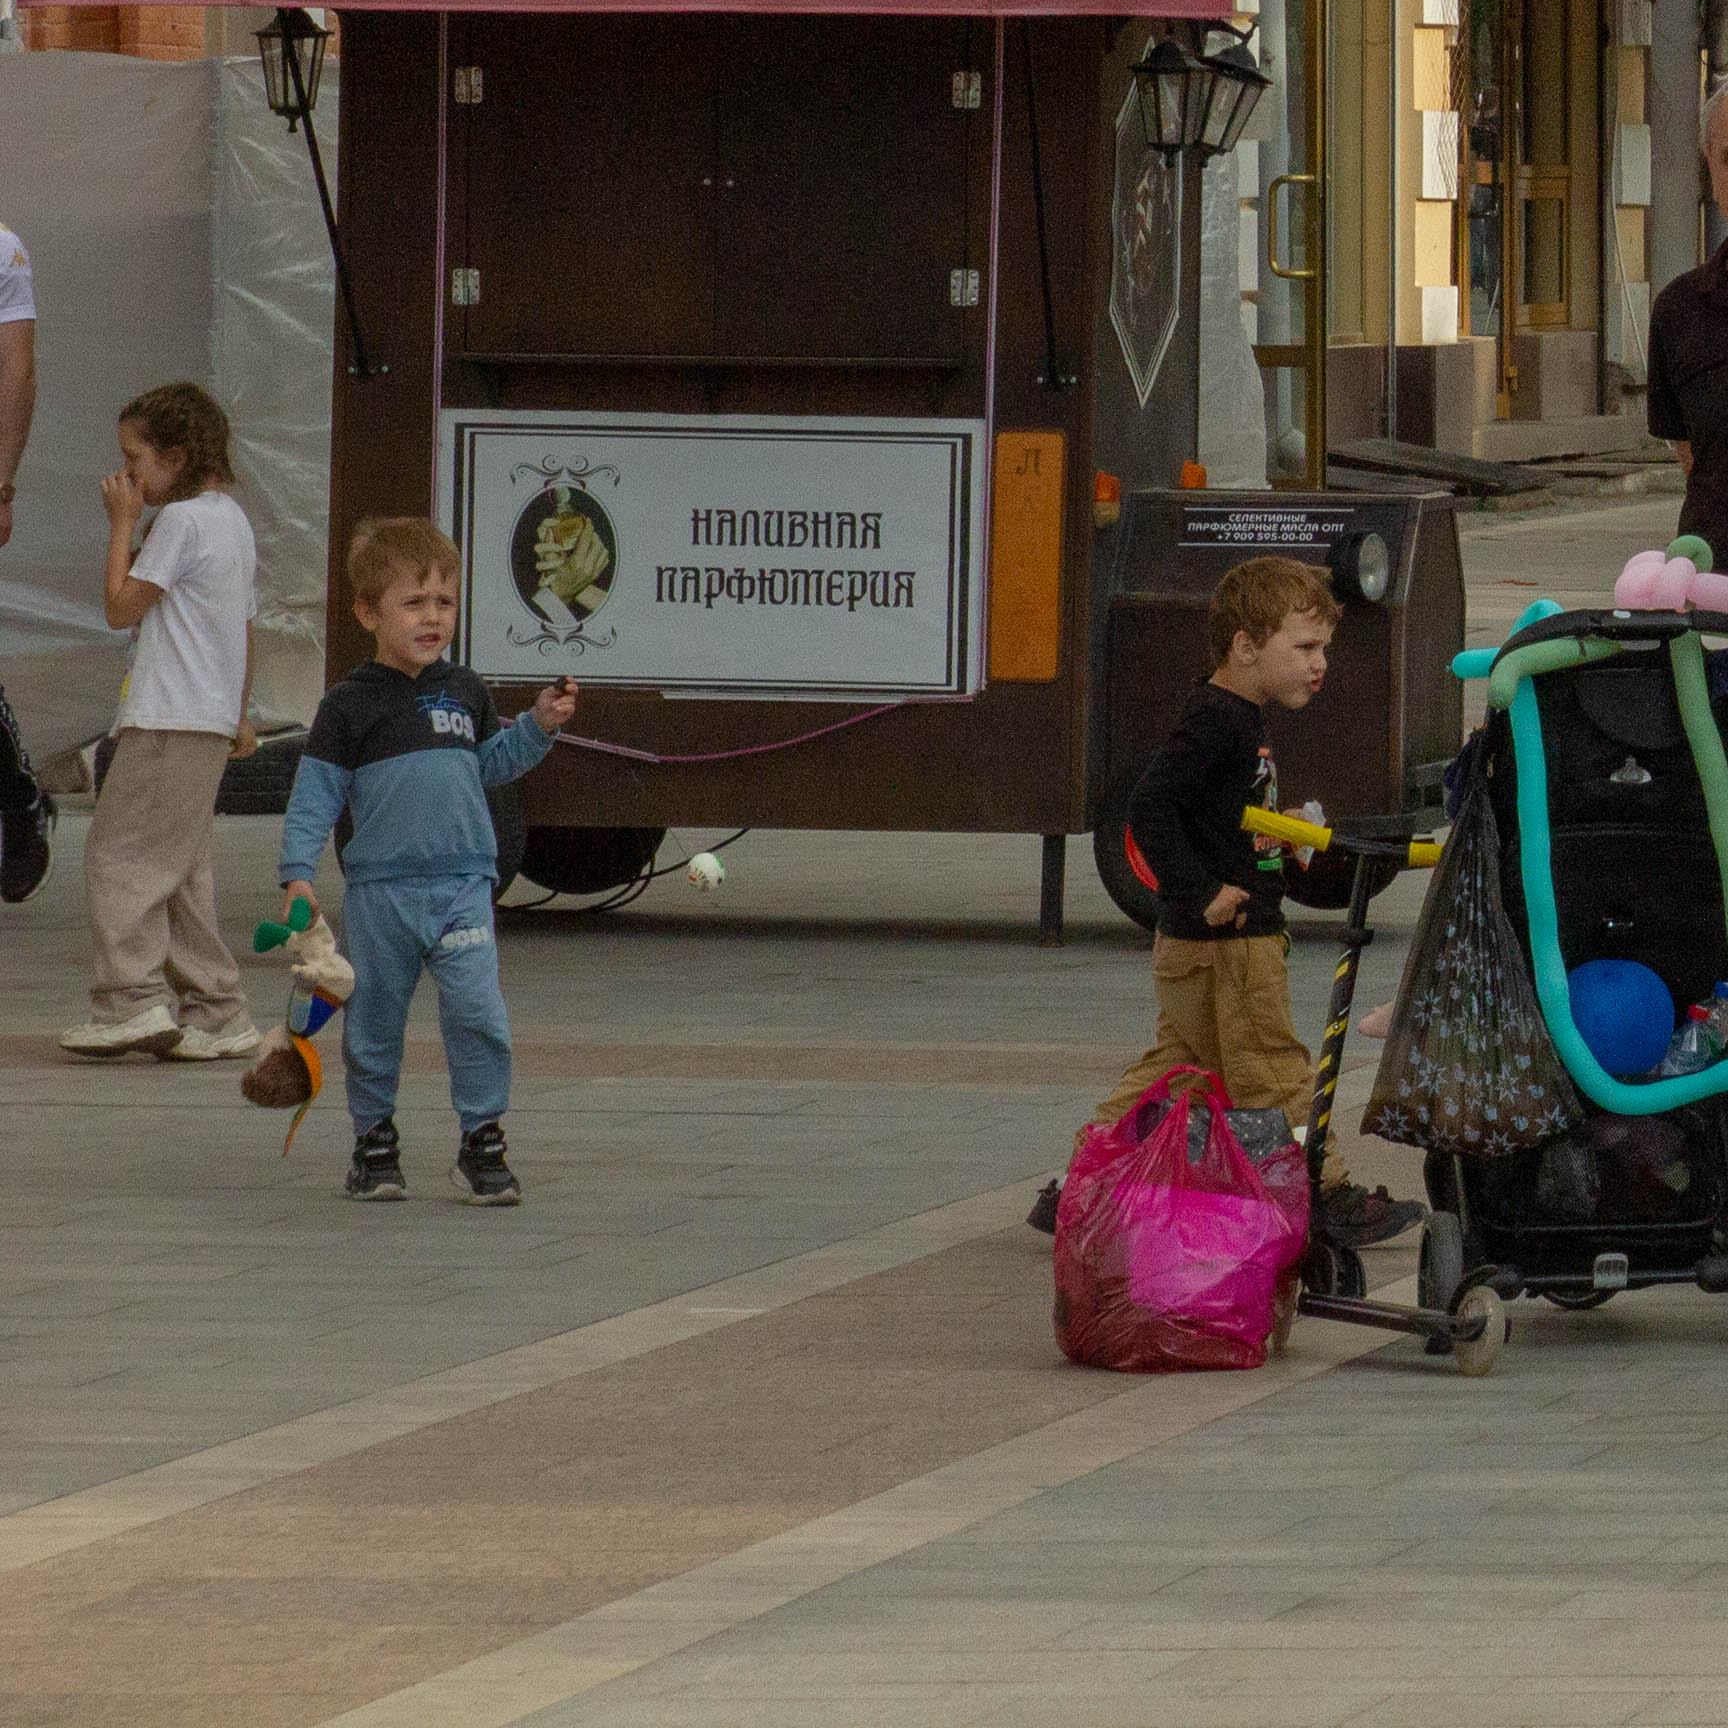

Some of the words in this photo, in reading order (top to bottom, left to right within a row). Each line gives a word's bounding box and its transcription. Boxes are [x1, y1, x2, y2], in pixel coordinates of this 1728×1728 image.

[1187, 522, 1278, 532] ПАРФЮМЕРНЫЕ
[1280, 523, 1319, 532] МАСЛА
[1321, 523, 1345, 533] ОПТ
[1228, 513, 1307, 522] СЕЛЕКТИВНЫЕ
[691, 508, 883, 550] НАЛИВНАЯ
[1218, 532, 1231, 541] +7
[1233, 532, 1255, 541] 909
[655, 566, 916, 612] ПАРФЮМЕРИЯ
[430, 709, 476, 743] BOS
